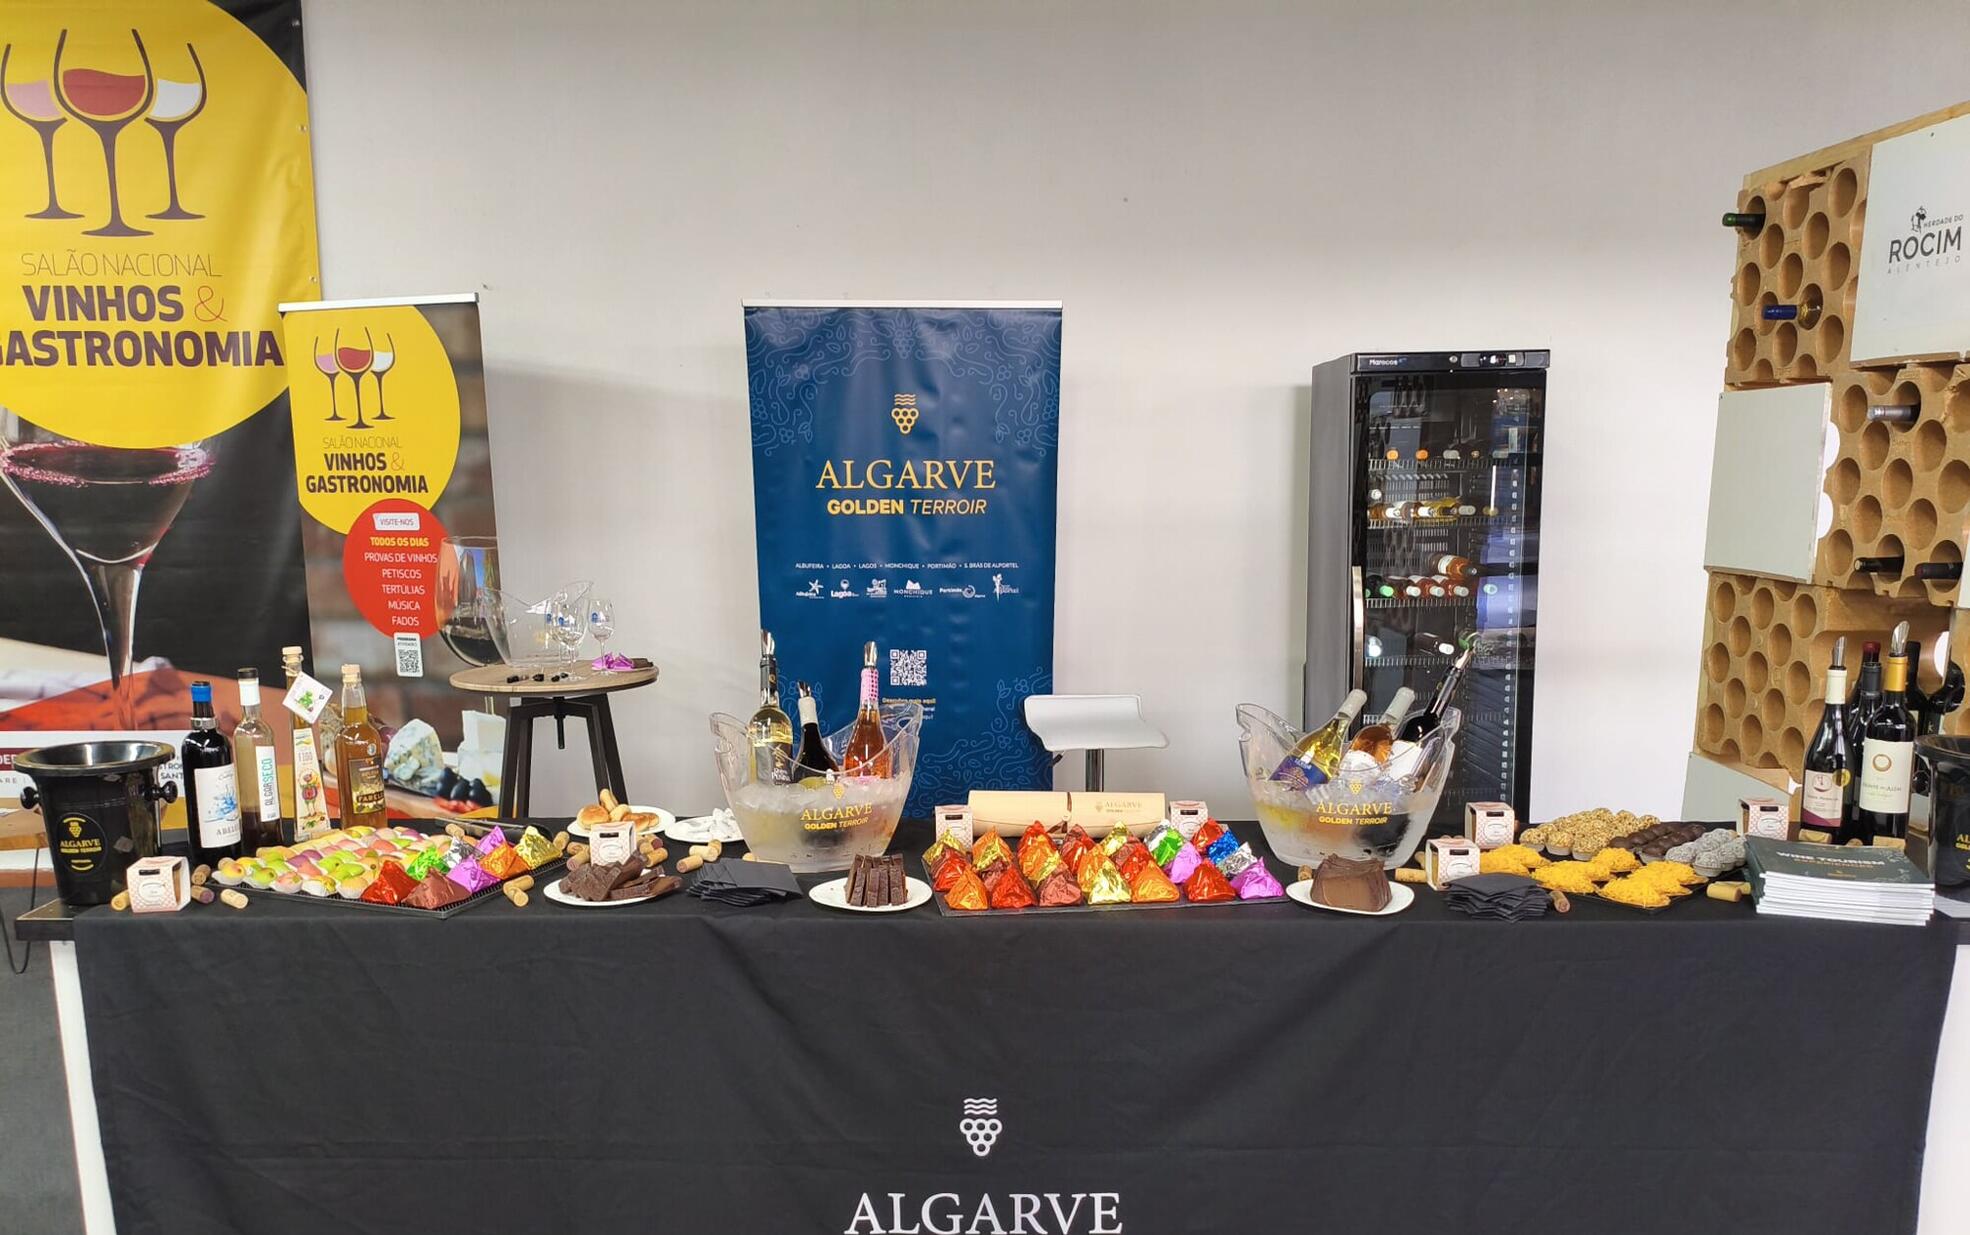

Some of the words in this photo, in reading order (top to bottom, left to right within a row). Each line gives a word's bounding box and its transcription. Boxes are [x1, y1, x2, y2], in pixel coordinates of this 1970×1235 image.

[1888, 226, 1962, 264] ROCIM
[21, 249, 98, 277] SALÃO
[103, 253, 223, 278] NACIONAL
[22, 285, 184, 323] VINHOS
[194, 285, 229, 323] &
[0, 330, 285, 367] ASTRONOMIA
[322, 435, 353, 449] SALÃO
[354, 436, 403, 449] NACIONAL
[324, 452, 387, 471] VINHOS
[391, 452, 407, 471] &
[815, 459, 996, 489] ALGARVE
[306, 475, 429, 493] GASTRONOMIA
[827, 499, 904, 515] GOLDEN
[910, 499, 988, 515] TERROIR
[380, 518, 414, 526] VISITE-NOS
[370, 537, 395, 546] TODOS
[397, 537, 409, 546] OS
[410, 537, 429, 546] DIAS
[364, 552, 394, 562] PROVAS
[395, 553, 406, 562] DE
[407, 553, 438, 563] VINHOS
[382, 568, 422, 579] PETISCOS
[382, 584, 425, 595] TERTÚLIAS
[388, 599, 421, 611] MÚSICA
[392, 616, 420, 626] FADOS
[800, 802, 873, 821] ALGARVE
[1316, 800, 1393, 816] ALGARVE
[804, 822, 837, 830] GOLDEN
[838, 817, 869, 828] TERROIR
[1319, 816, 1353, 825] GOLDEN
[1355, 816, 1388, 825] TERROIR
[60, 838, 101, 848] ALGARVE
[843, 1191, 1124, 1235] ALGARVE
